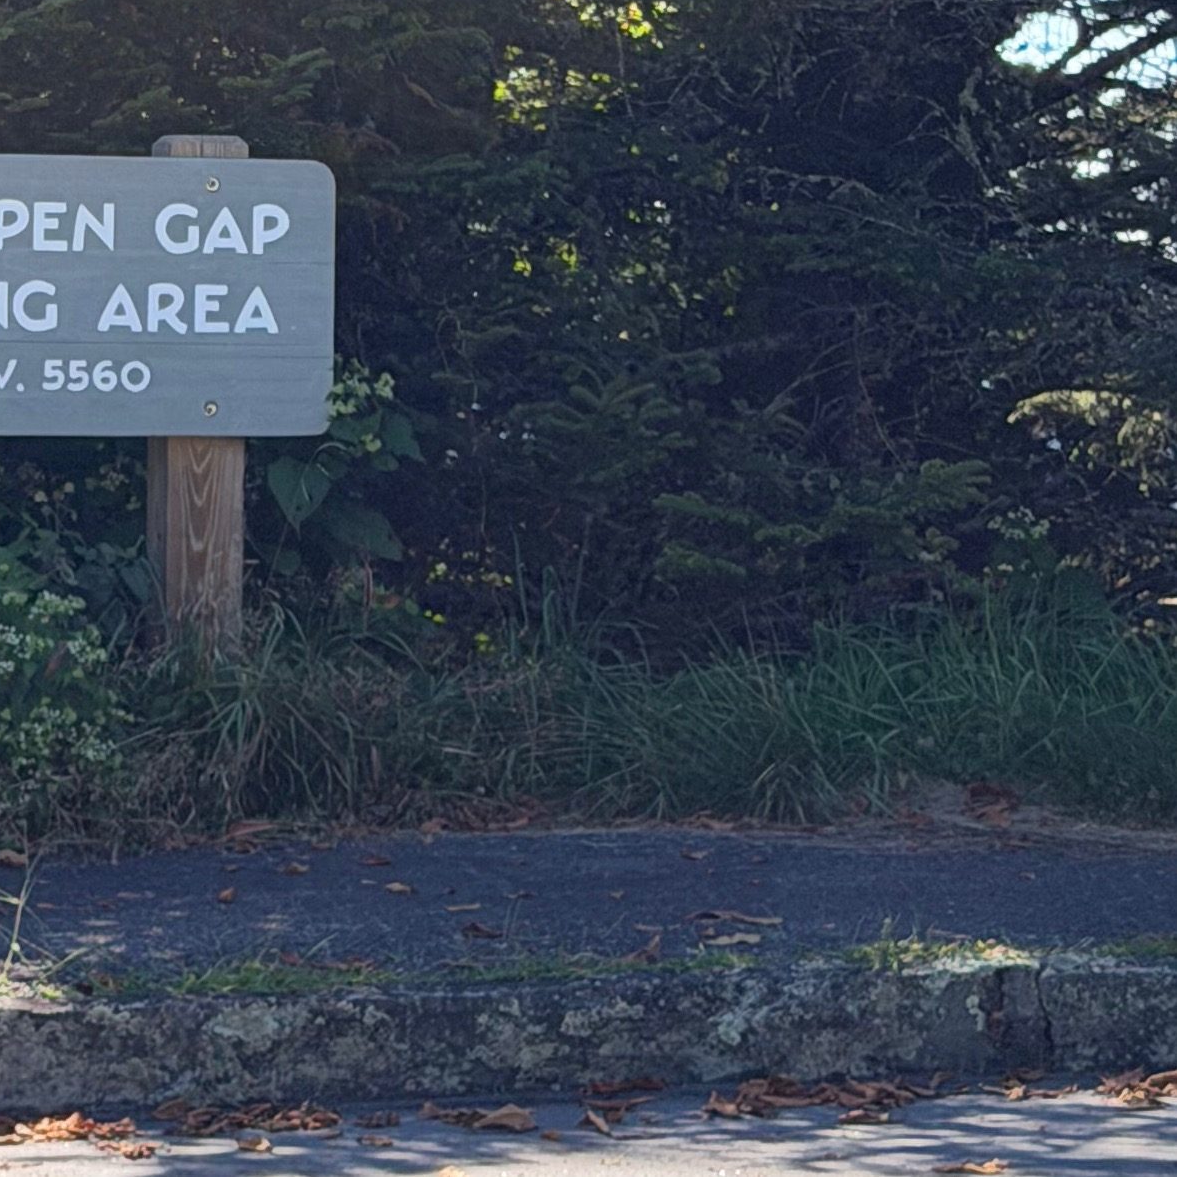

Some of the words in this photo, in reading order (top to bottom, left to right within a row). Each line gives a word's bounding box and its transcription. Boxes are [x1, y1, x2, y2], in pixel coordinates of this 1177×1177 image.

[155, 203, 290, 255] GAP
[97, 283, 279, 334] AREA
[42, 359, 151, 392] 5560
